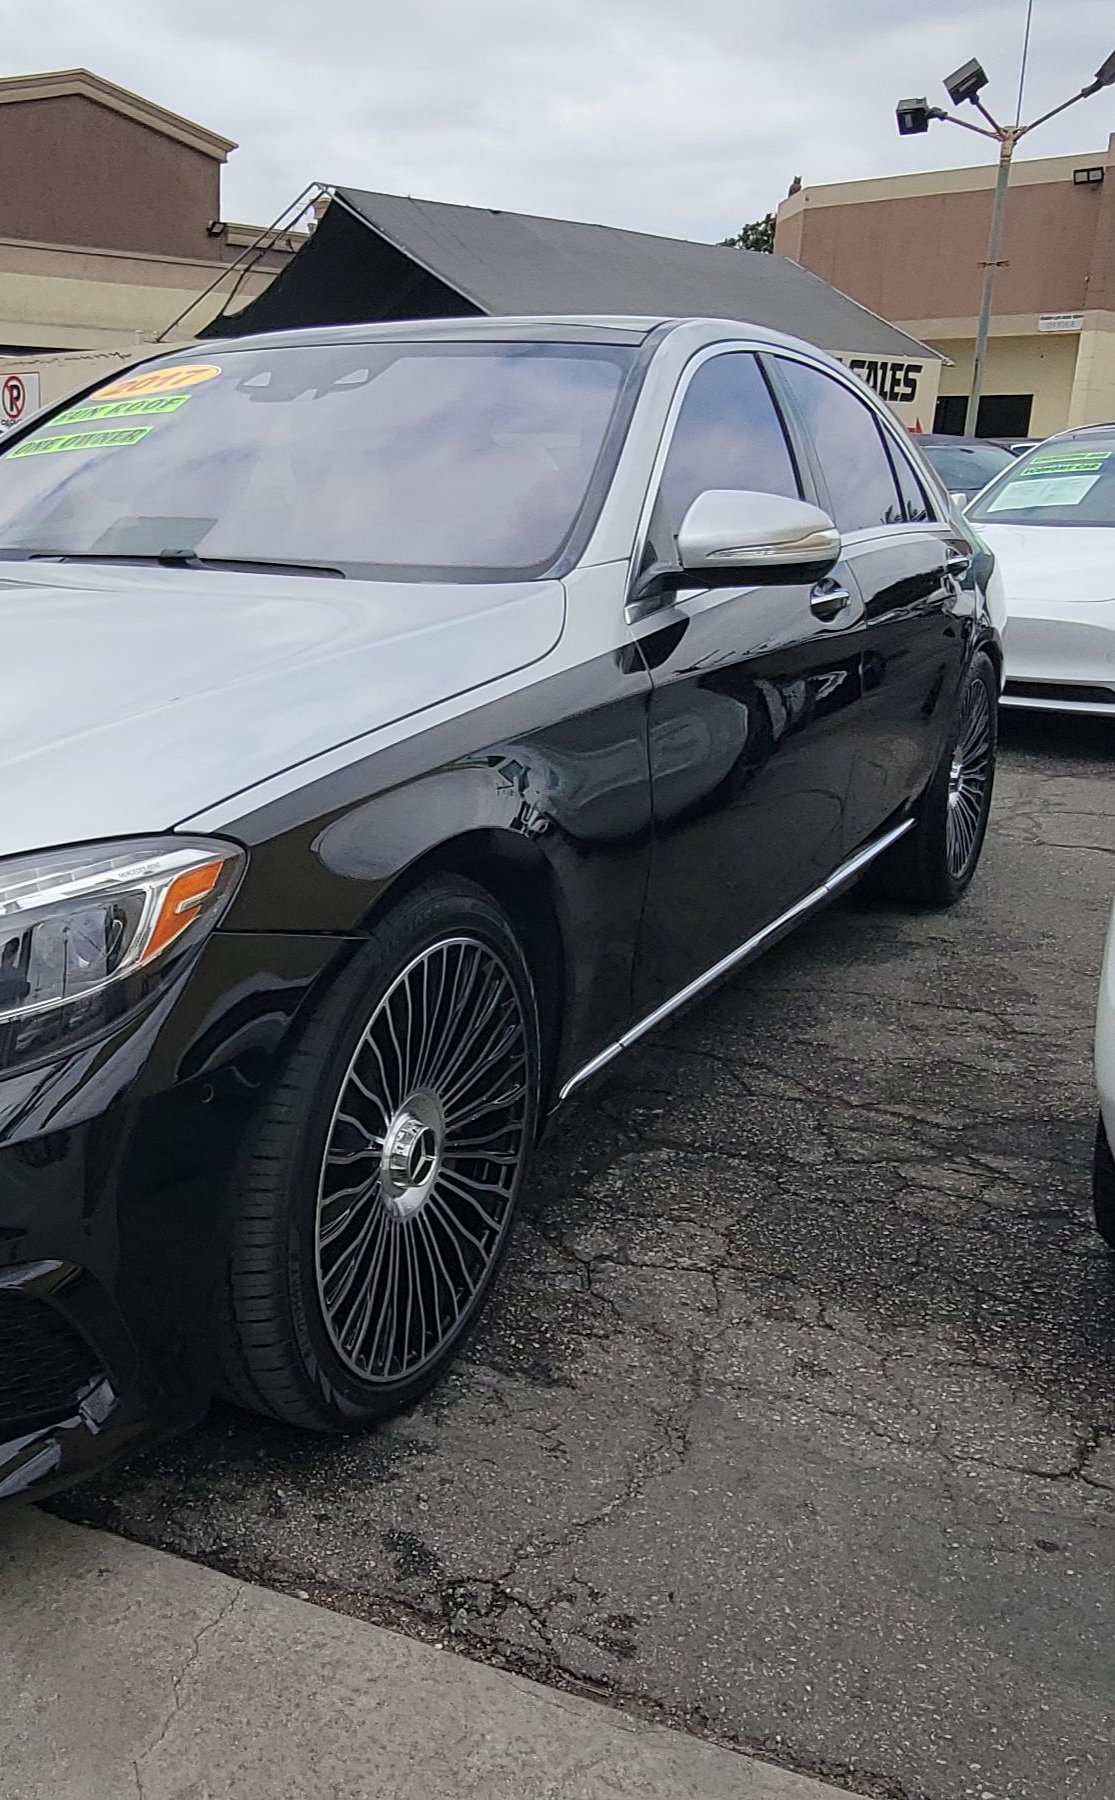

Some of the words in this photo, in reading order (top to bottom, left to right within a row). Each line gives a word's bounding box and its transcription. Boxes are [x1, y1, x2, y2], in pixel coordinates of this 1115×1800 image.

[100, 369, 211, 398] 2017
[103, 396, 187, 417] ROOF
[12, 437, 65, 457] ONE
[57, 428, 148, 450] OWNER
